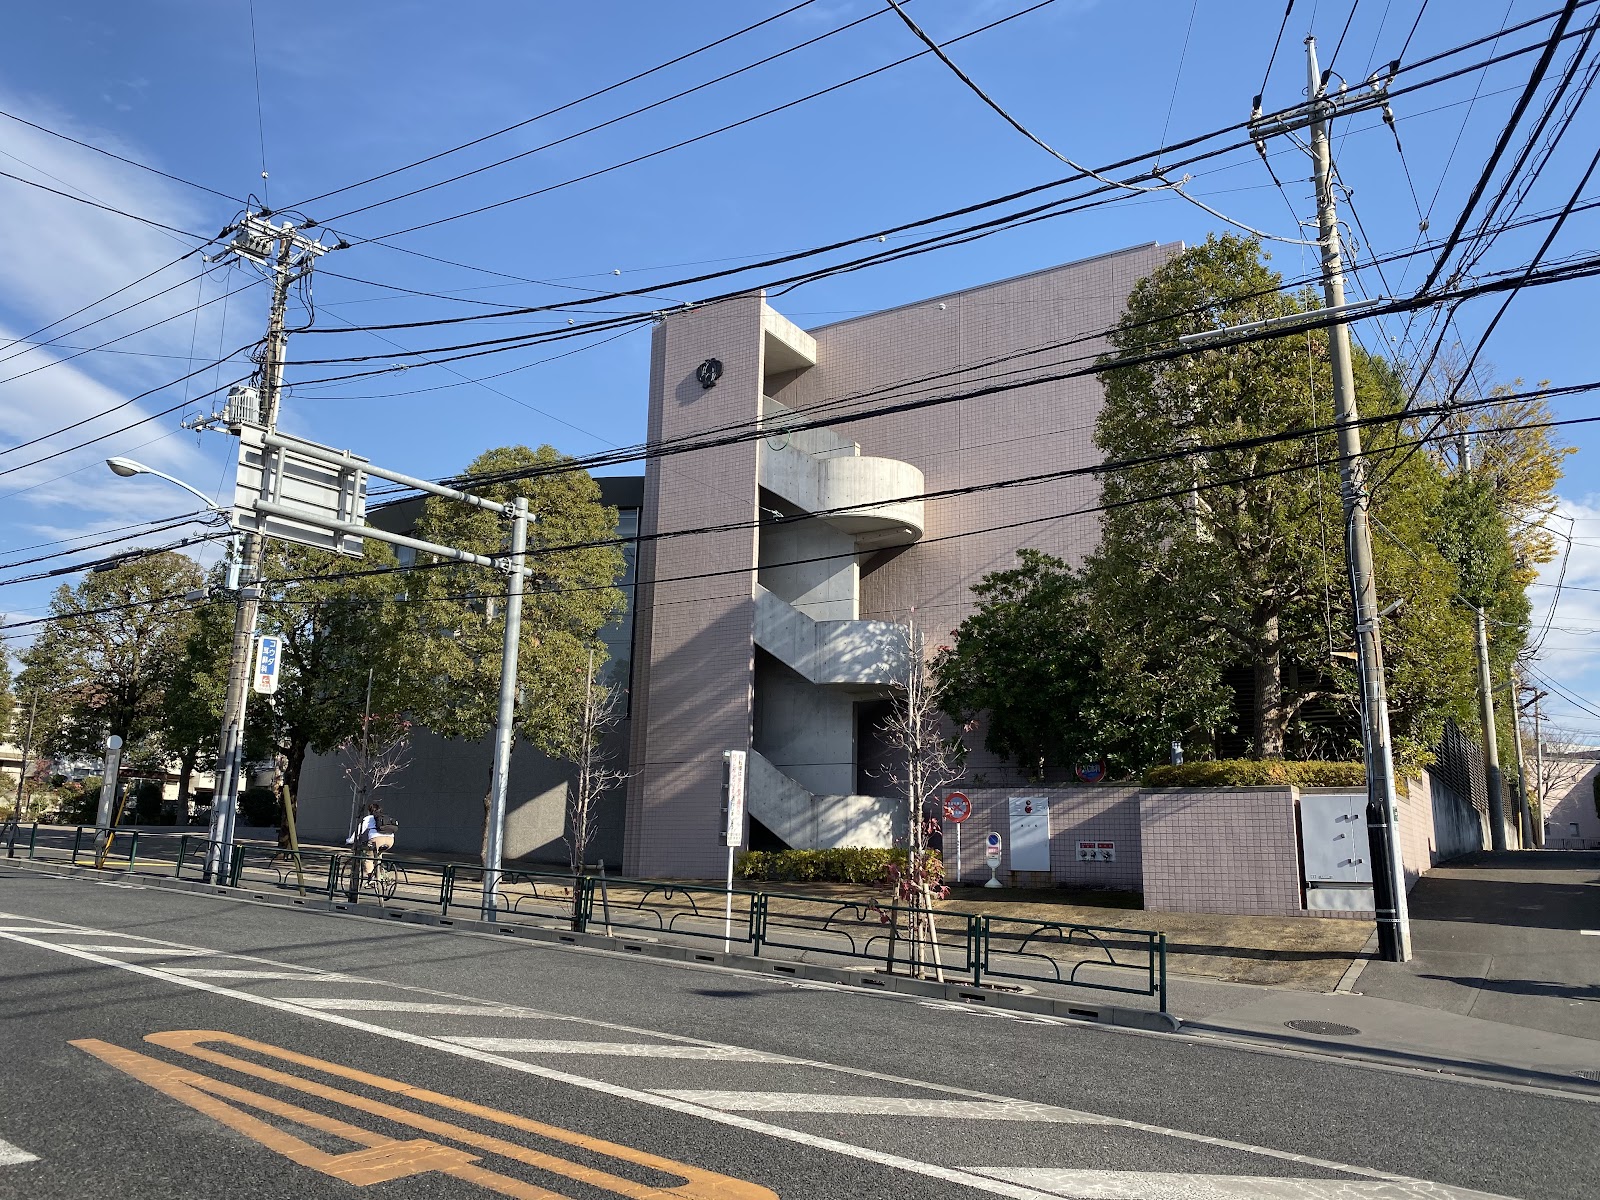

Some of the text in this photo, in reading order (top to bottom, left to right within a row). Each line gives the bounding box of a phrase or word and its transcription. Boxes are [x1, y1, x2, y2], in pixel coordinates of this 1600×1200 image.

[261, 647, 270, 673] 耳鼻科
[267, 640, 276, 666] コウダ
